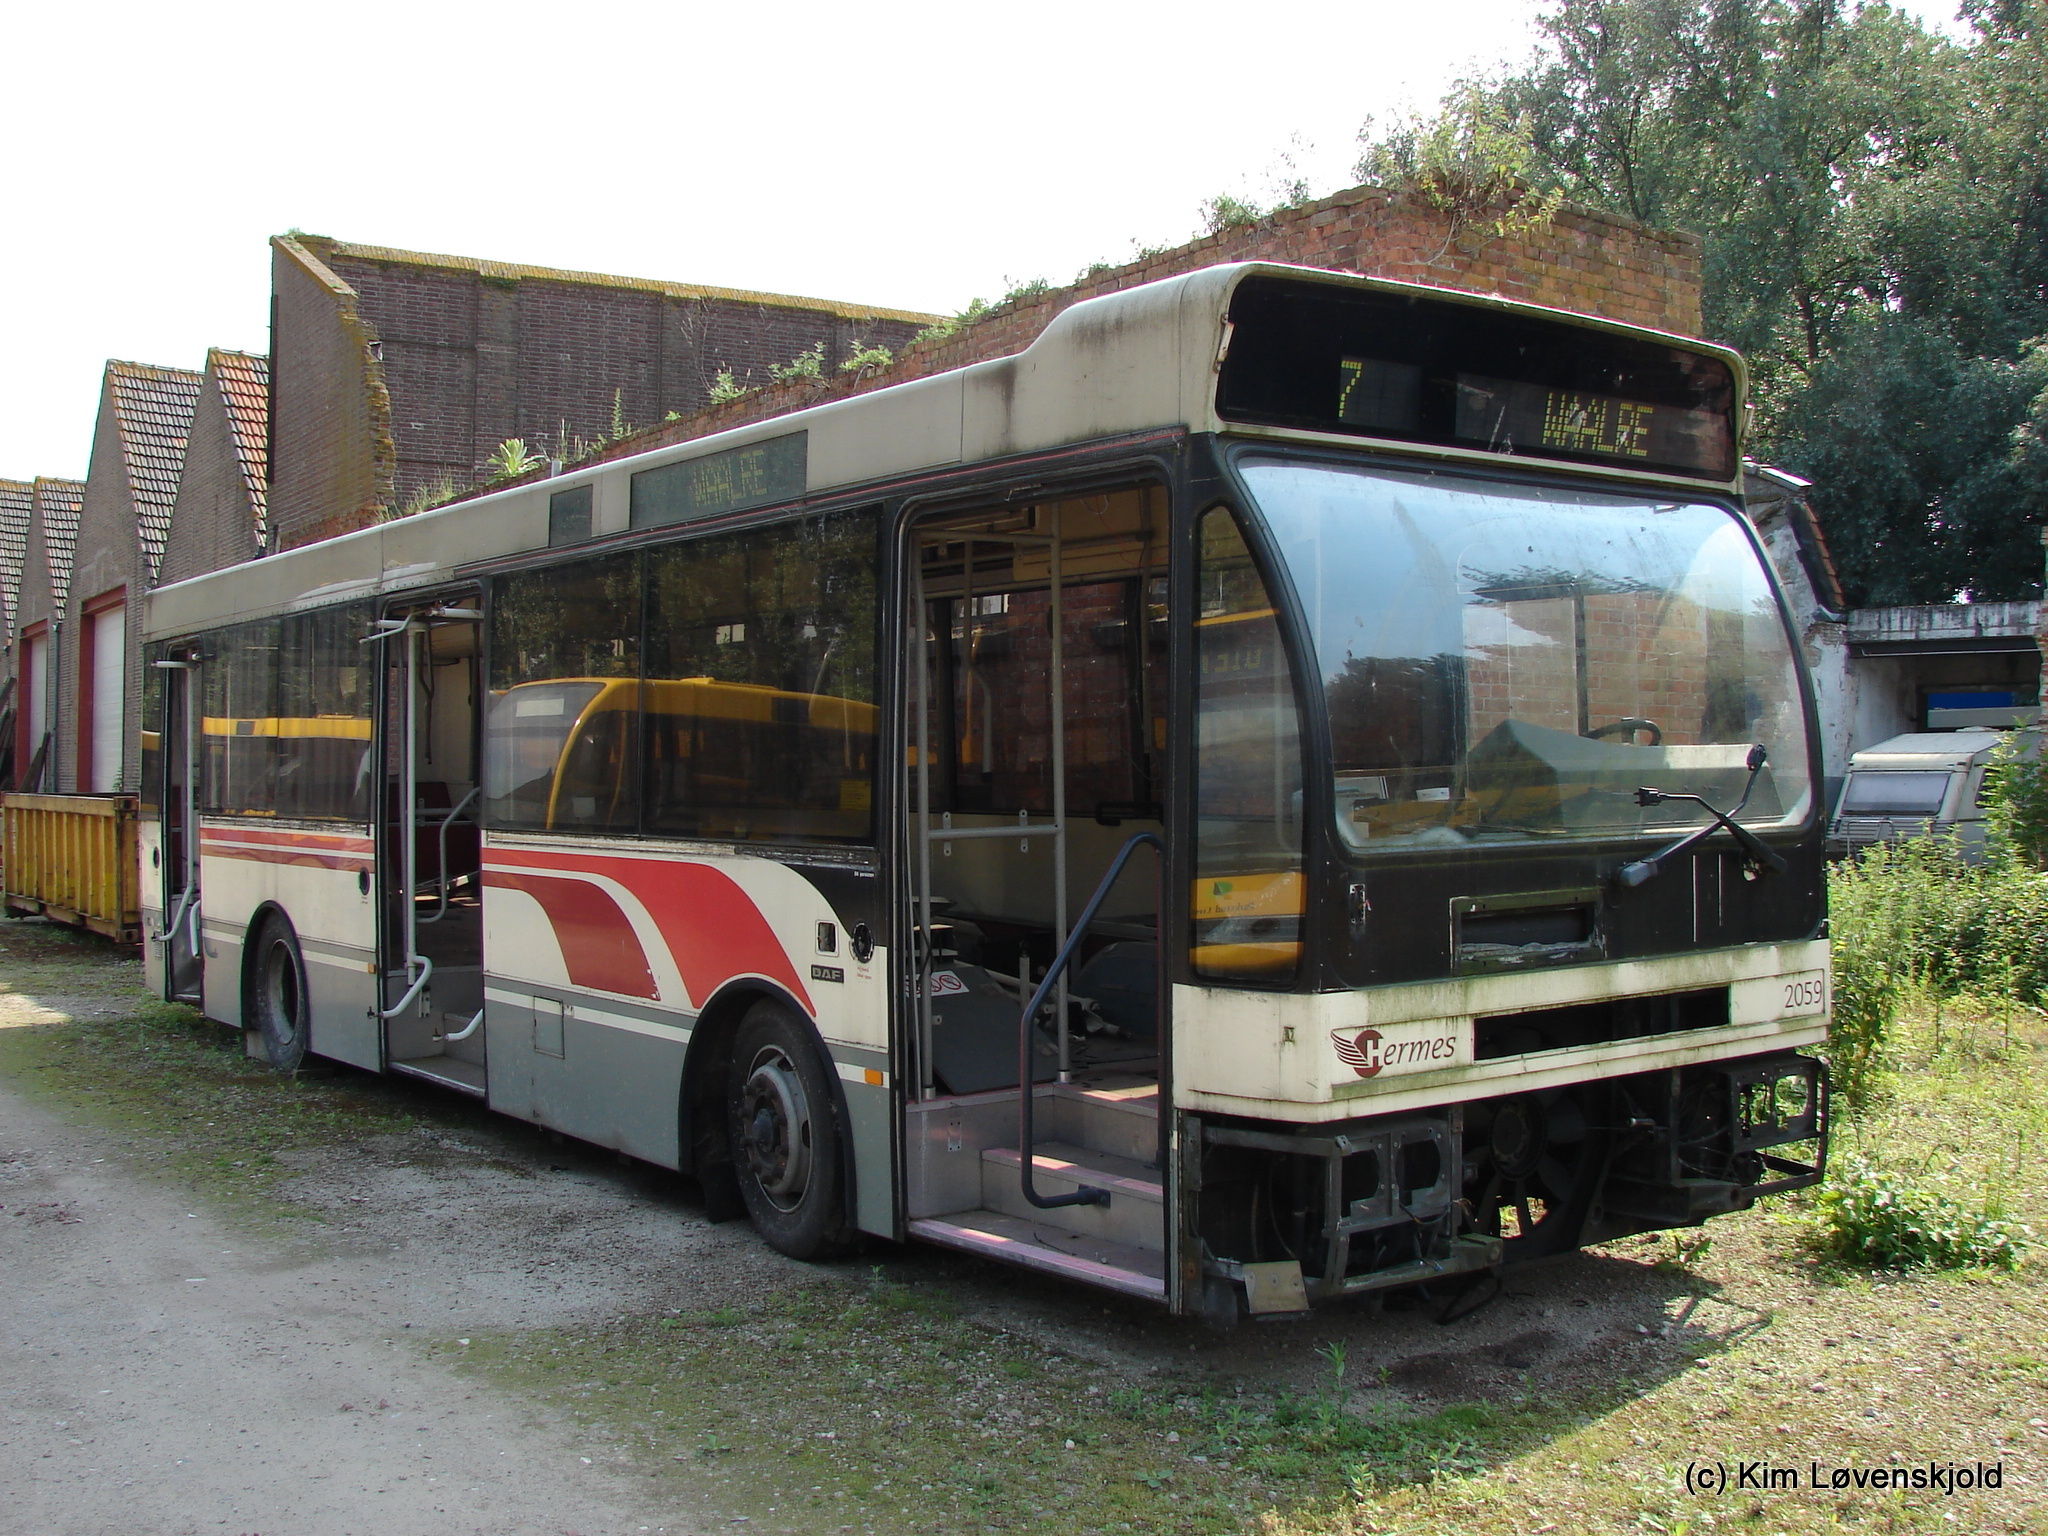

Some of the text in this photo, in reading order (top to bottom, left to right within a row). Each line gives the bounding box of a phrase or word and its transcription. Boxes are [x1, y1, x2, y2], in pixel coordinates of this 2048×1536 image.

[1340, 361, 1362, 418] 7
[812, 967, 841, 980] DAF
[1784, 980, 1822, 1008] 2059
[1364, 1036, 1456, 1068] Hermes
